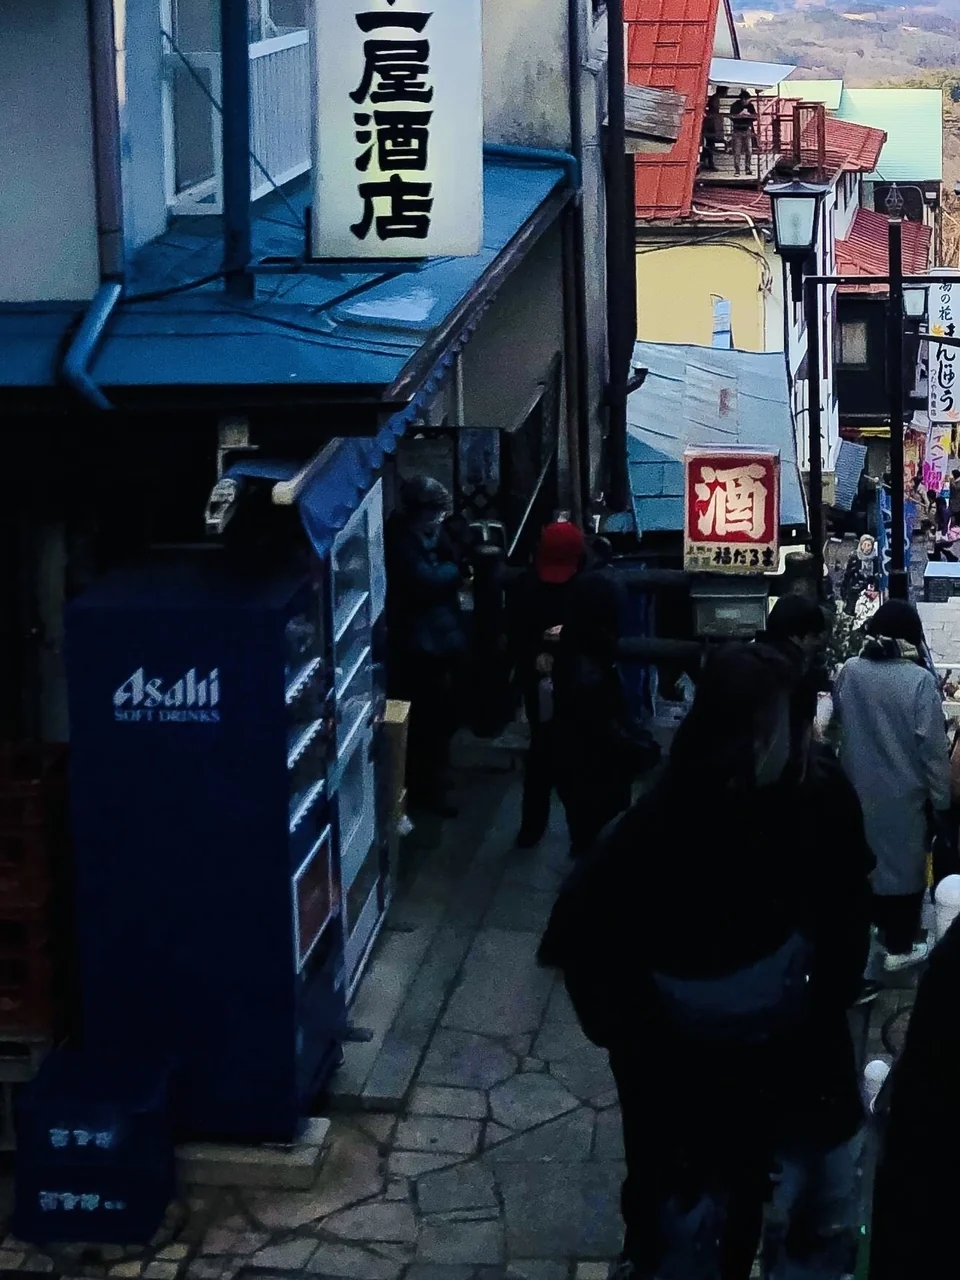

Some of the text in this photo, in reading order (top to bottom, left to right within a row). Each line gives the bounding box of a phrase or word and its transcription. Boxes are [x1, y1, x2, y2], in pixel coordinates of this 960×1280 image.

[694, 462, 768, 540] 酒
[712, 546, 774, 567] 福だるま
[112, 665, 221, 708] Asahi
[114, 709, 221, 723] SOFT DRINKS
